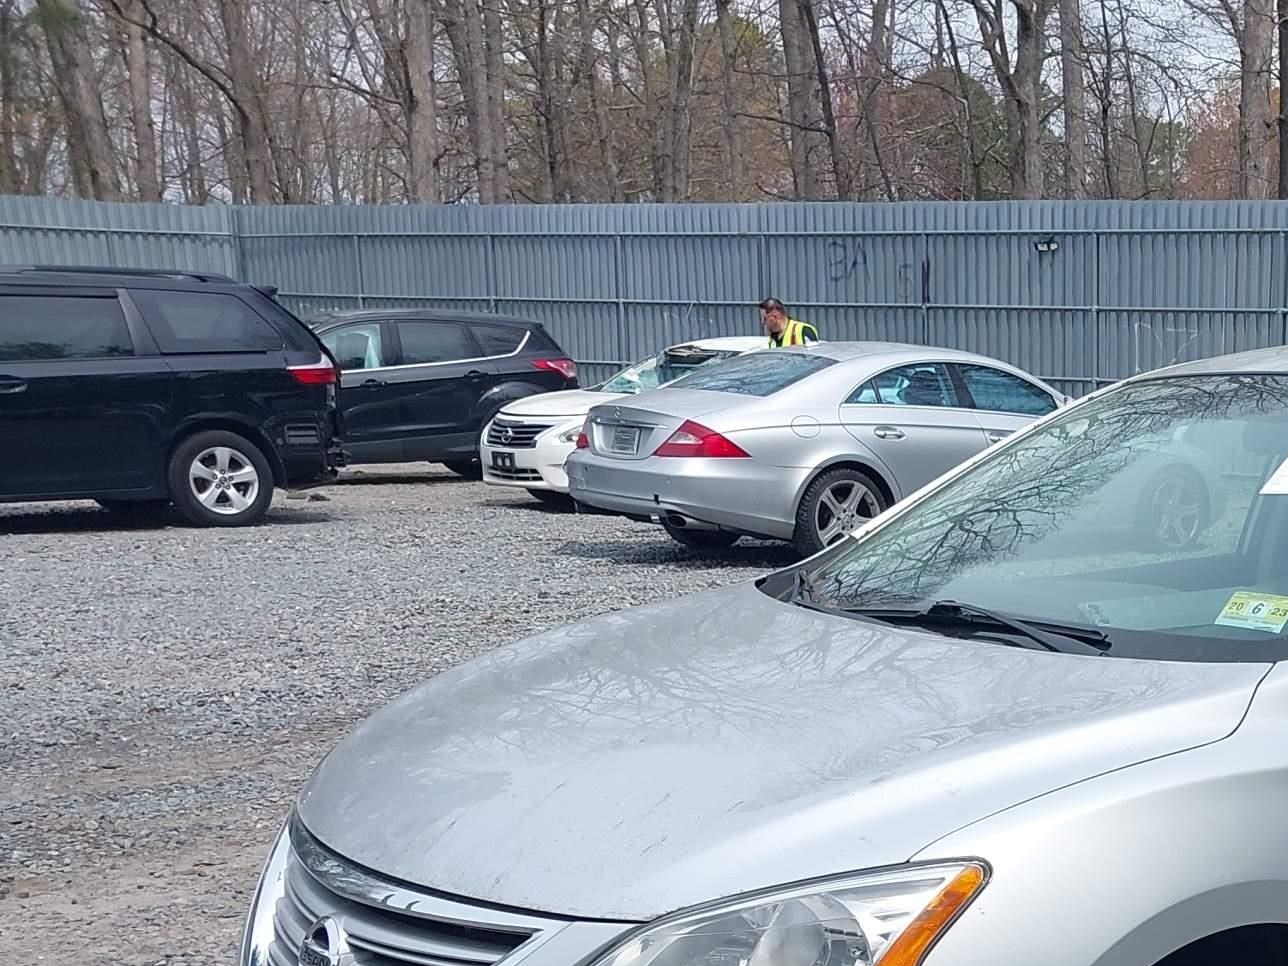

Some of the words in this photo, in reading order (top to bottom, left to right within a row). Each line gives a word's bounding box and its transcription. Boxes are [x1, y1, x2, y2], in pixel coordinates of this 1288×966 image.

[1228, 602, 1245, 611] 20
[1252, 602, 1265, 615] 6
[1270, 607, 1288, 617] 23
